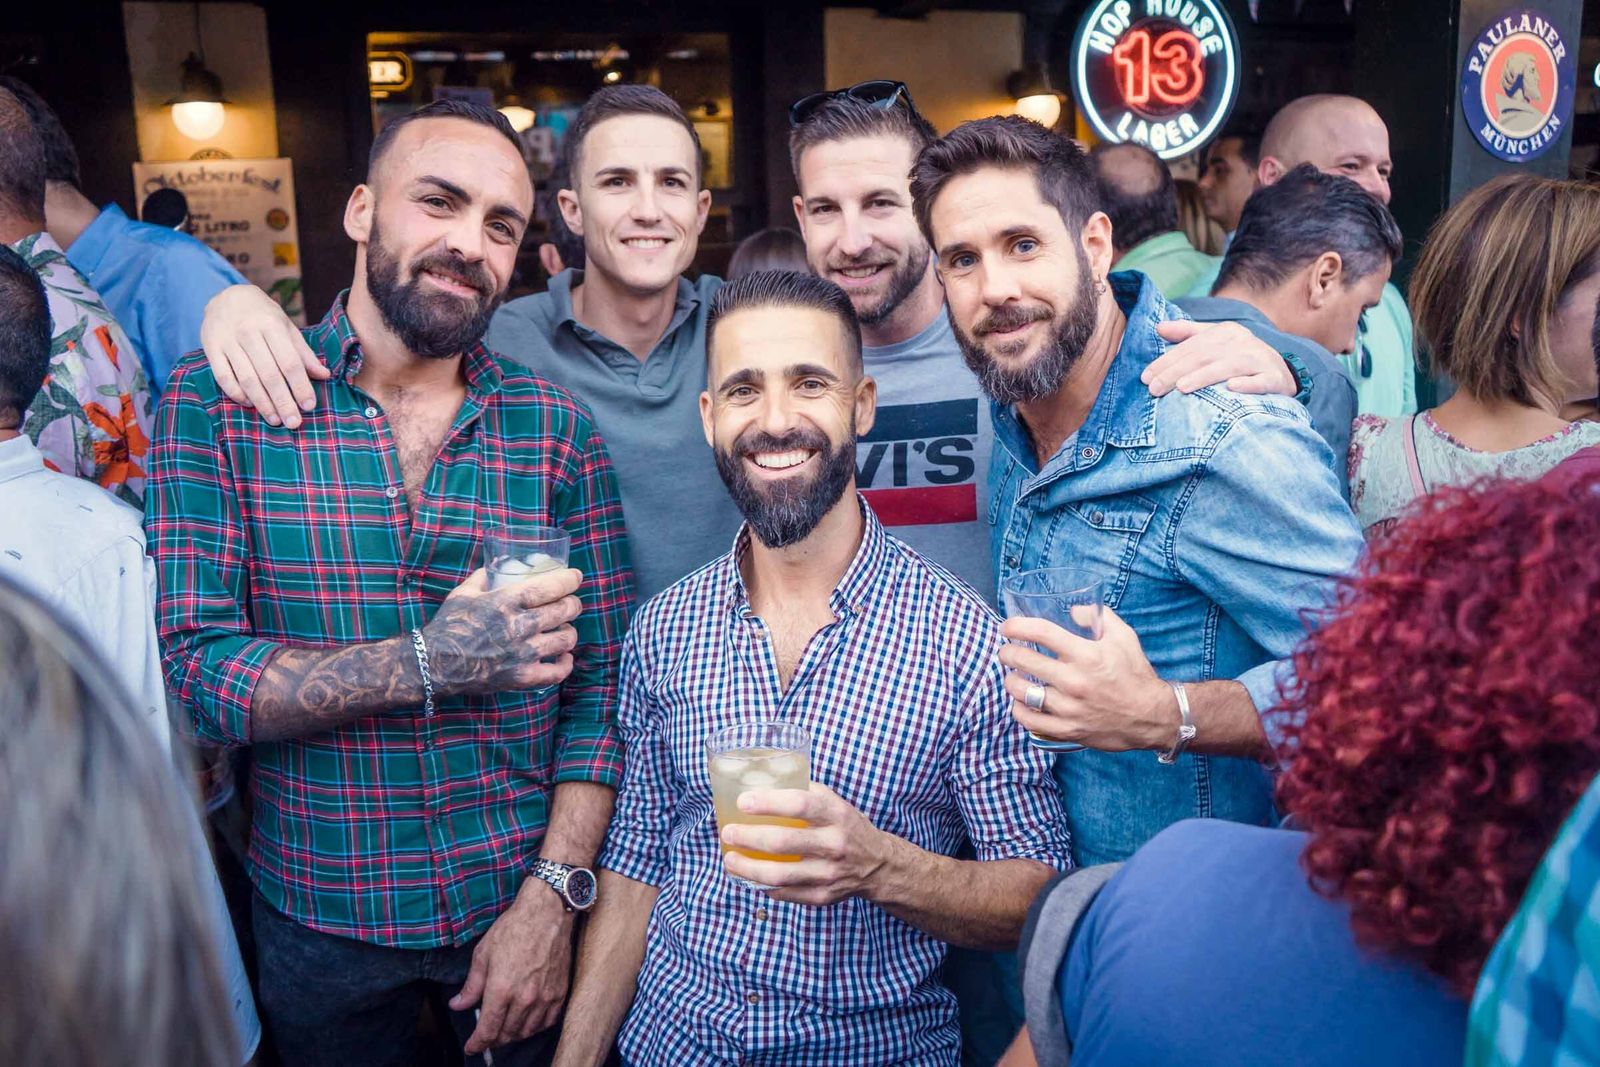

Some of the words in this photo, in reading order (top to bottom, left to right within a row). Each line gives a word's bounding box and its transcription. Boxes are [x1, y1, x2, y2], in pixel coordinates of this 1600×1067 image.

[1089, 0, 1131, 54] HOP
[1147, 0, 1224, 57] HOUSE
[1468, 13, 1566, 75] PAULANER
[1113, 30, 1203, 104] 13
[1116, 111, 1200, 150] LAGER
[1480, 113, 1561, 154] MÜNCHEN
[854, 437, 975, 488] VI'S
